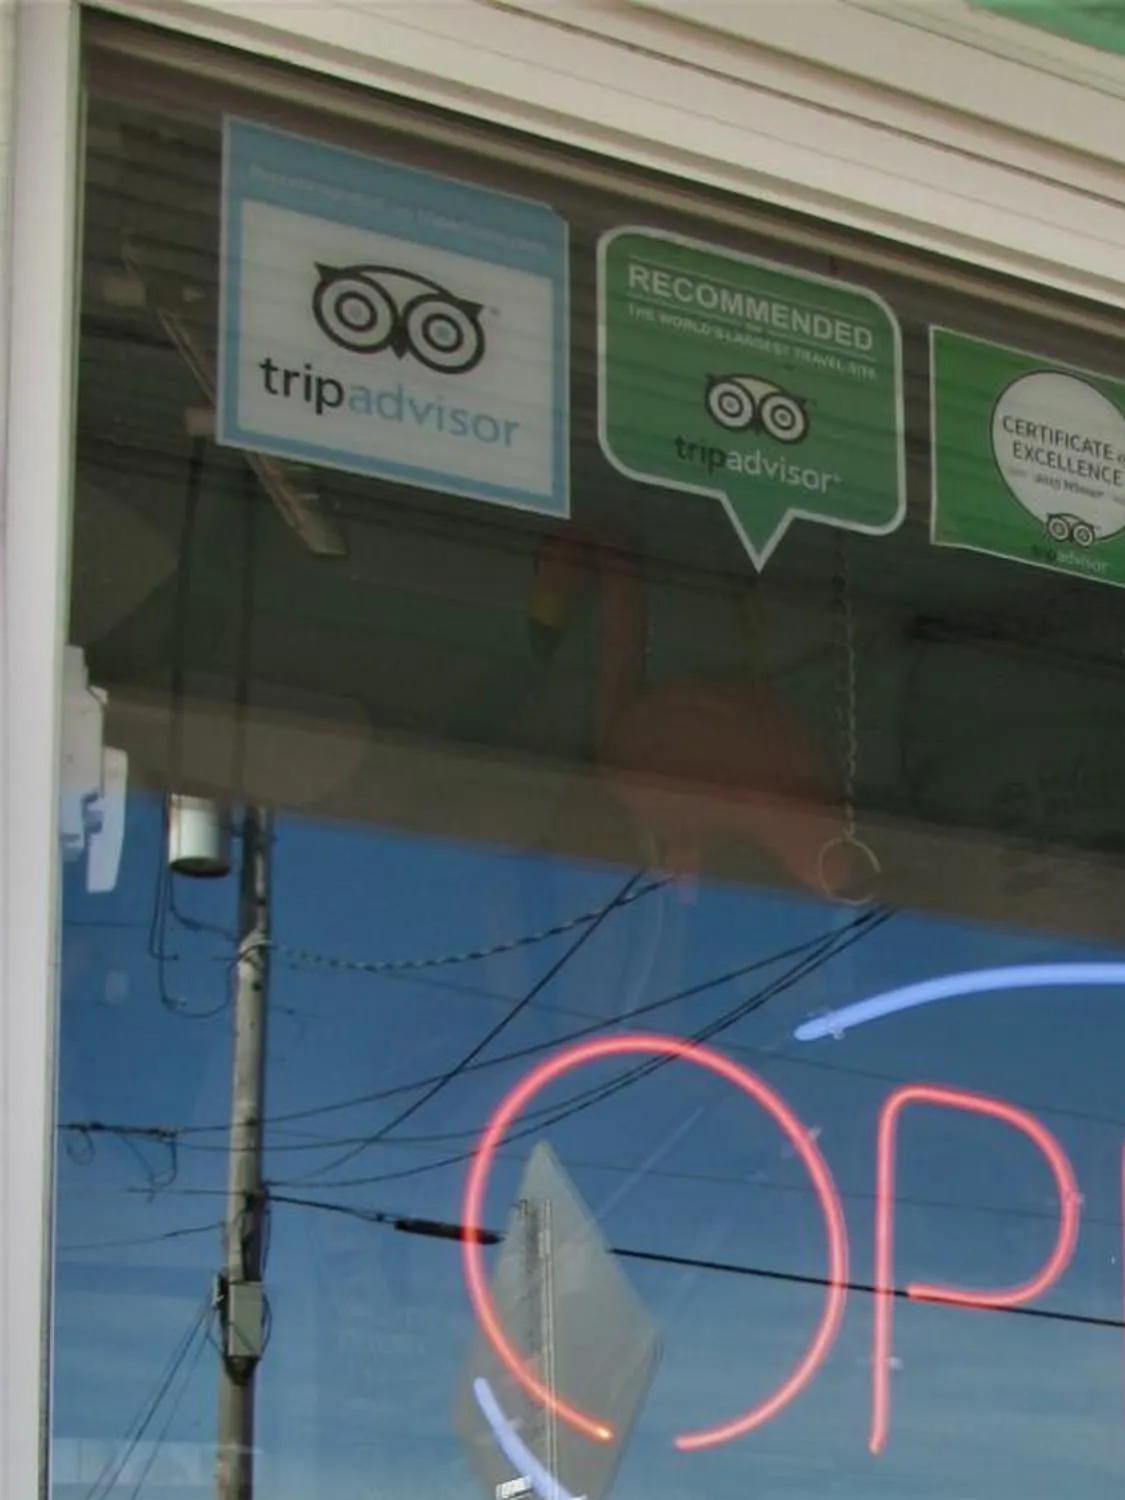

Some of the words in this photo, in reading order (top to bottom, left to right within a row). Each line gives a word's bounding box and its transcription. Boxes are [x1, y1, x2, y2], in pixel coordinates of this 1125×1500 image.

[627, 264, 874, 350] RECOMMENDED
[259, 356, 520, 448] tripadvisor
[674, 434, 833, 493] tripadvisor
[1002, 415, 1114, 461] CERTIFICATE
[1012, 441, 1125, 487] EXCELLENCE
